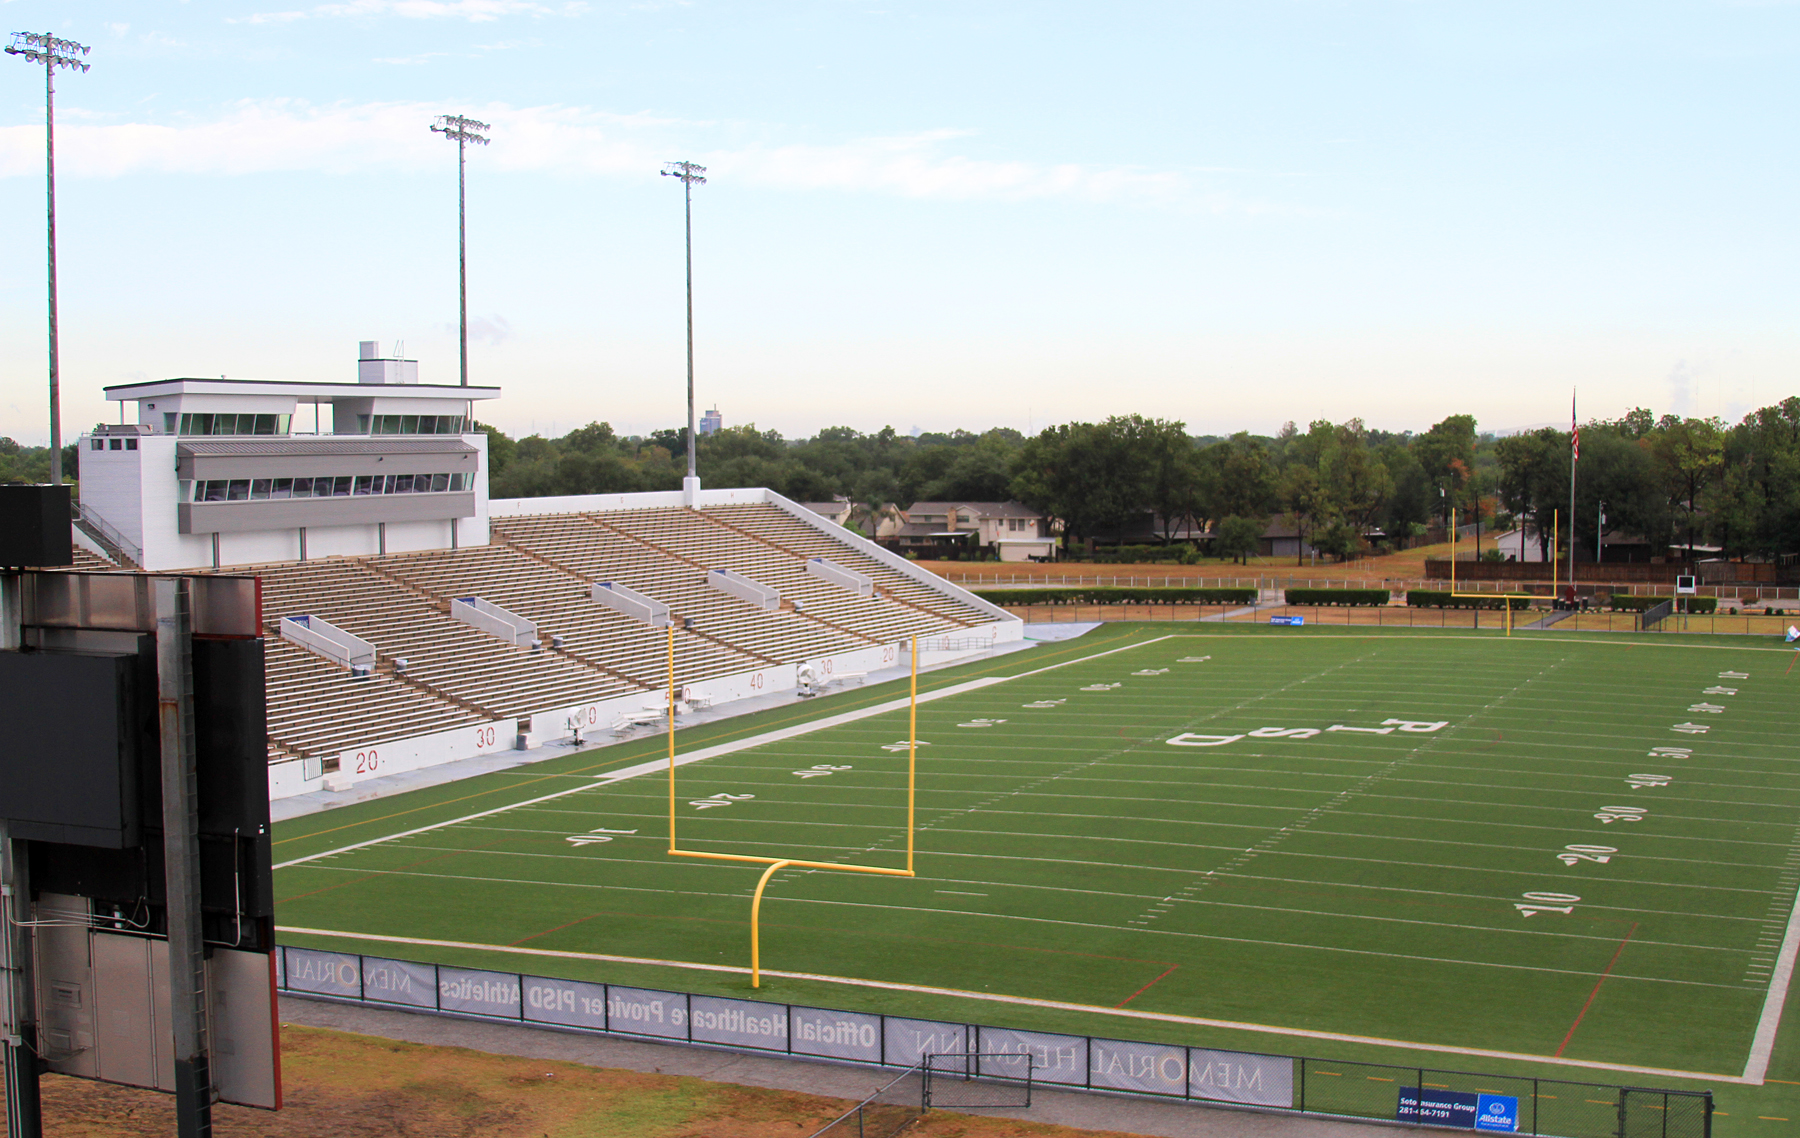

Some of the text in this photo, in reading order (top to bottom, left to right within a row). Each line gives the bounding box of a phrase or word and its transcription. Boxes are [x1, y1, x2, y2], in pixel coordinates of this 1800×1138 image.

[883, 646, 895, 662] 20
[821, 659, 833, 675] 30
[750, 672, 765, 691] 40
[476, 727, 495, 748] 30
[356, 749, 378, 774] 20
[1594, 806, 1648, 821] 30
[1556, 844, 1618, 864] 20
[1514, 891, 1581, 914] 10
[1400, 1097, 1476, 1113] Soto nsurance Group
[1479, 1113, 1512, 1125] Allstate
